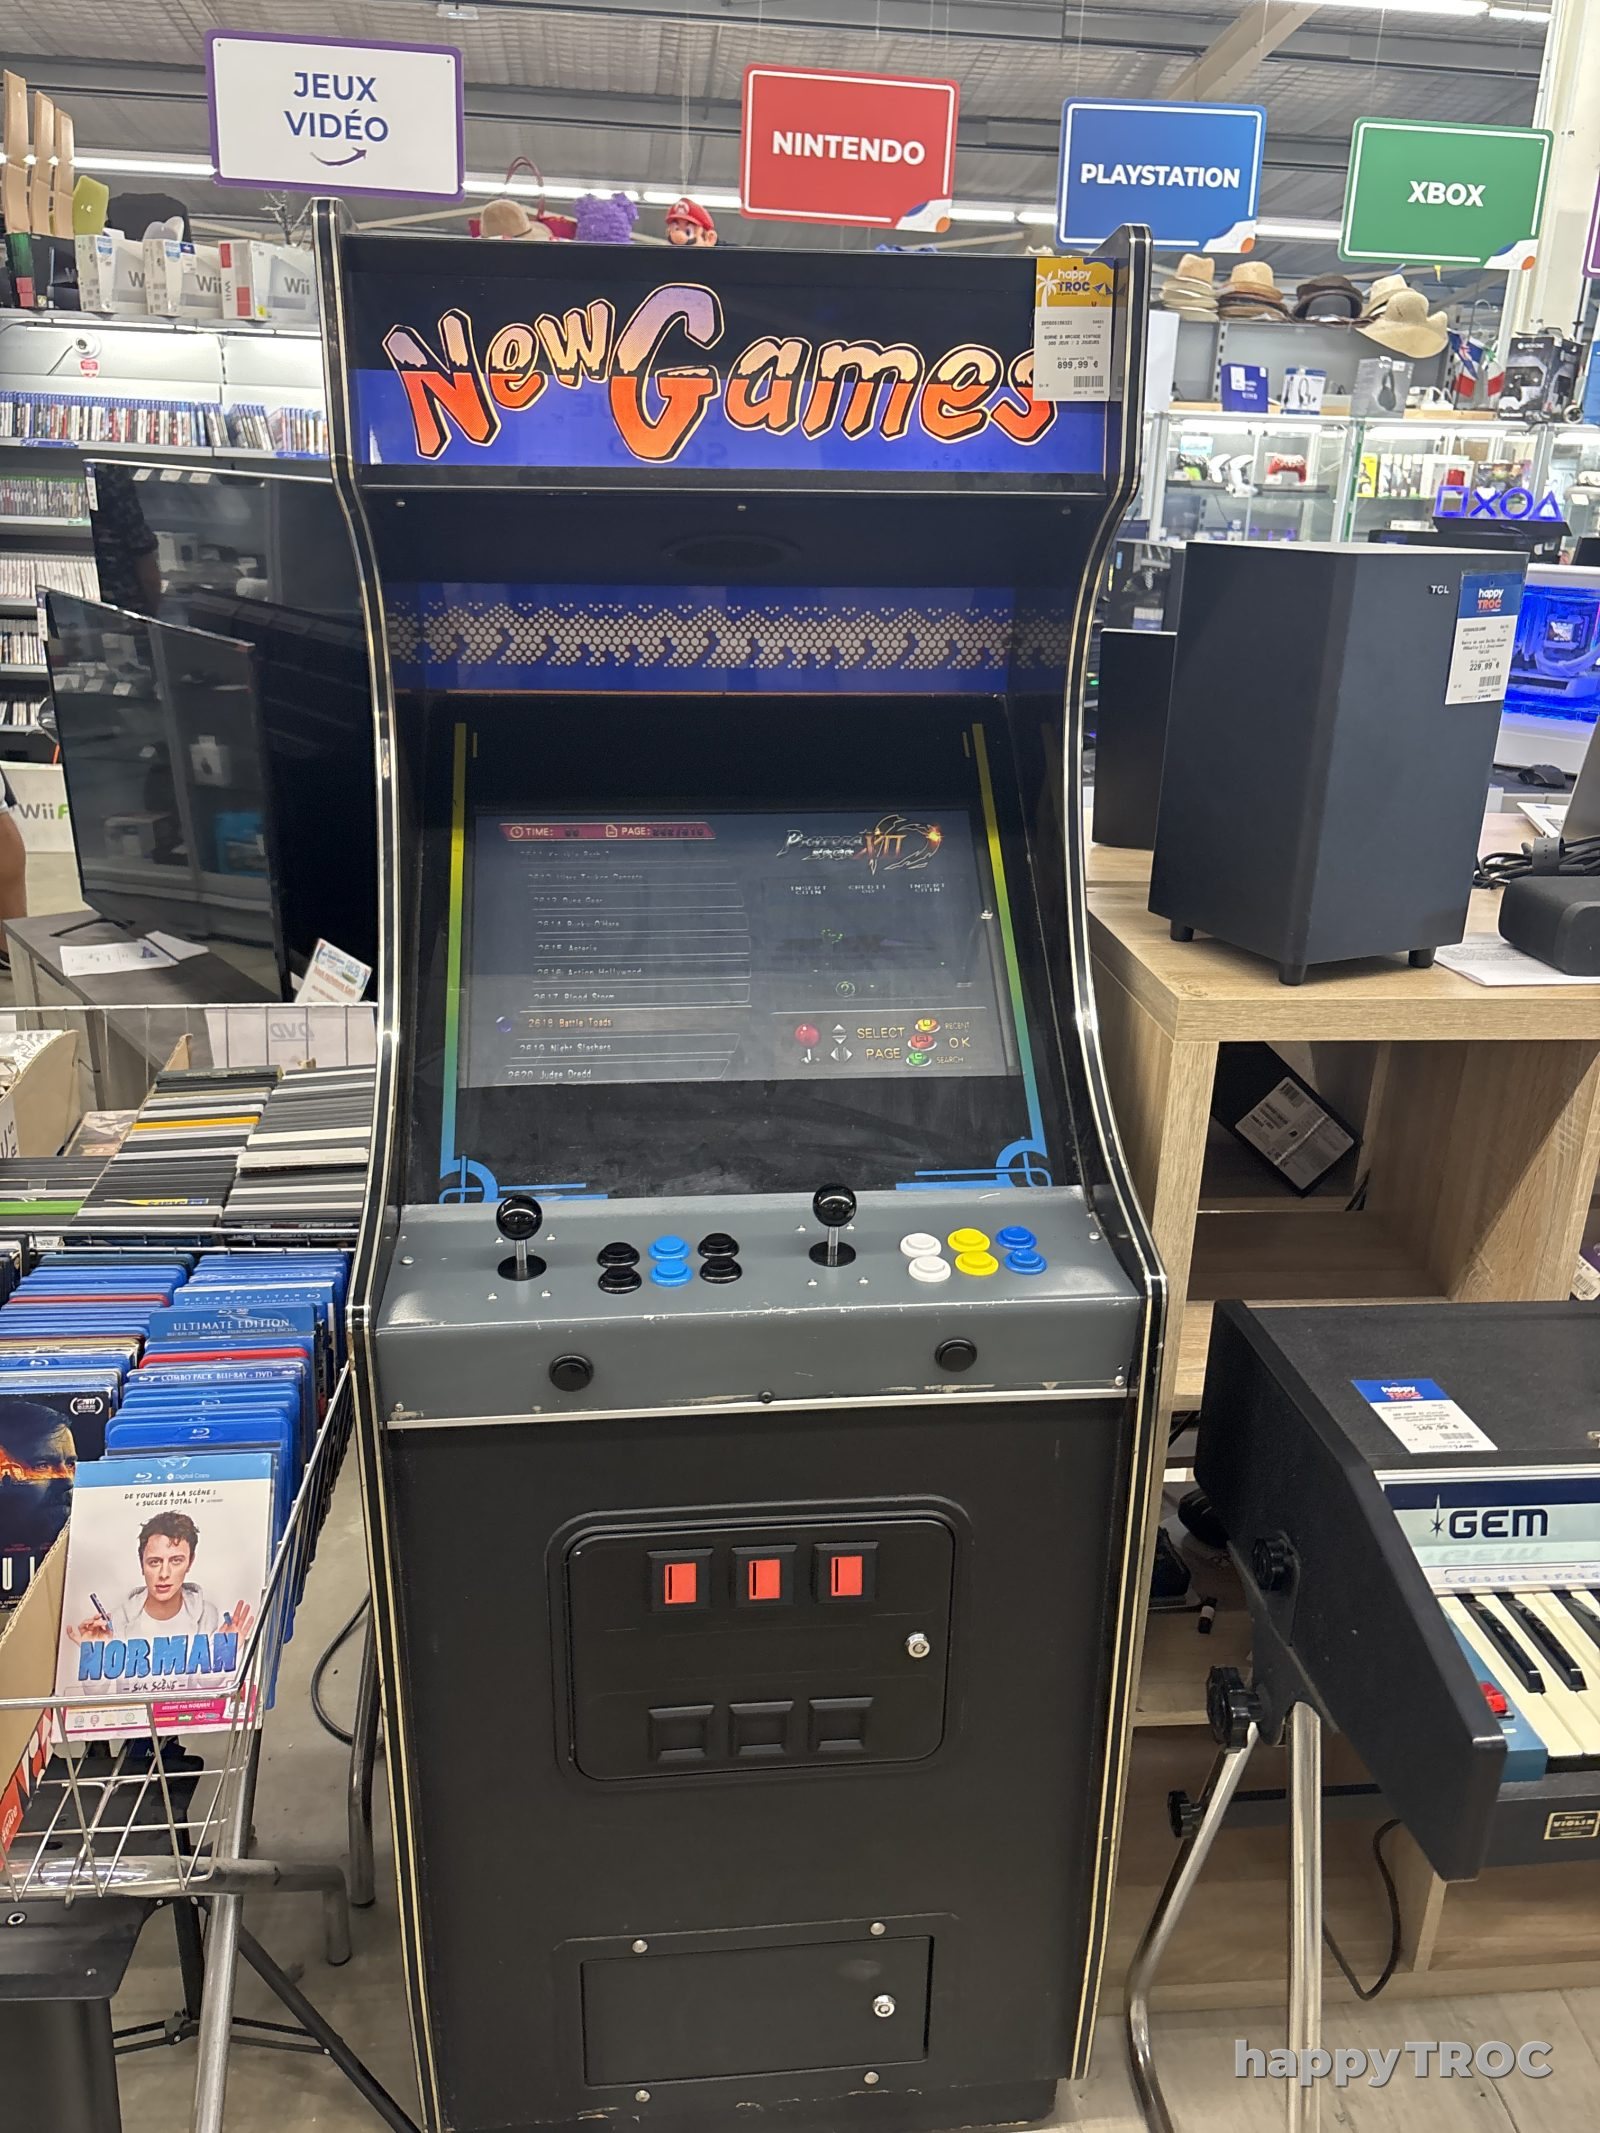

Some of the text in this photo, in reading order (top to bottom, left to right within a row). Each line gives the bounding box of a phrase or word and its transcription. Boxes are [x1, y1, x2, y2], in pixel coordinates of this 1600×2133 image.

[293, 72, 378, 102] JEUX
[284, 108, 389, 142] VIDÉO
[773, 131, 925, 165] NINTENDO
[1080, 163, 1240, 189] PLAYSTATION
[1407, 181, 1486, 207] XBOX
[1058, 269, 1091, 281] happy
[284, 277, 310, 295] Wii
[1058, 281, 1090, 292] TROC
[1057, 361, 1088, 370] 899,99
[609, 283, 1058, 463] Games
[1430, 585, 1450, 594] TCL
[1478, 588, 1504, 599] happy
[1478, 599, 1502, 609] TROC
[18, 803, 54, 819] Wii
[525, 827, 553, 836] TIME:
[621, 827, 651, 836] PAGE:
[559, 1018, 584, 1027] Battle
[588, 1018, 612, 1027] Toads
[857, 1027, 905, 1039] SELECT
[949, 1037, 971, 1048] OK
[866, 1048, 901, 1059] PAGE
[936, 1056, 964, 1064] SEARCH
[539, 1069, 565, 1079] Judge
[568, 1069, 592, 1078] Dredd
[173, 1319, 290, 1331] ULTIMATE EDITION
[161, 1374, 191, 1382] COMBO
[193, 1373, 212, 1381] PACK
[216, 1371, 247, 1380] BLU-RAY
[136, 1491, 167, 1499] YOUTUBE
[1449, 1509, 1548, 1538] GEM
[78, 1632, 238, 1681] NORMAN
[131, 1678, 175, 1692] SUR SCÈNE
